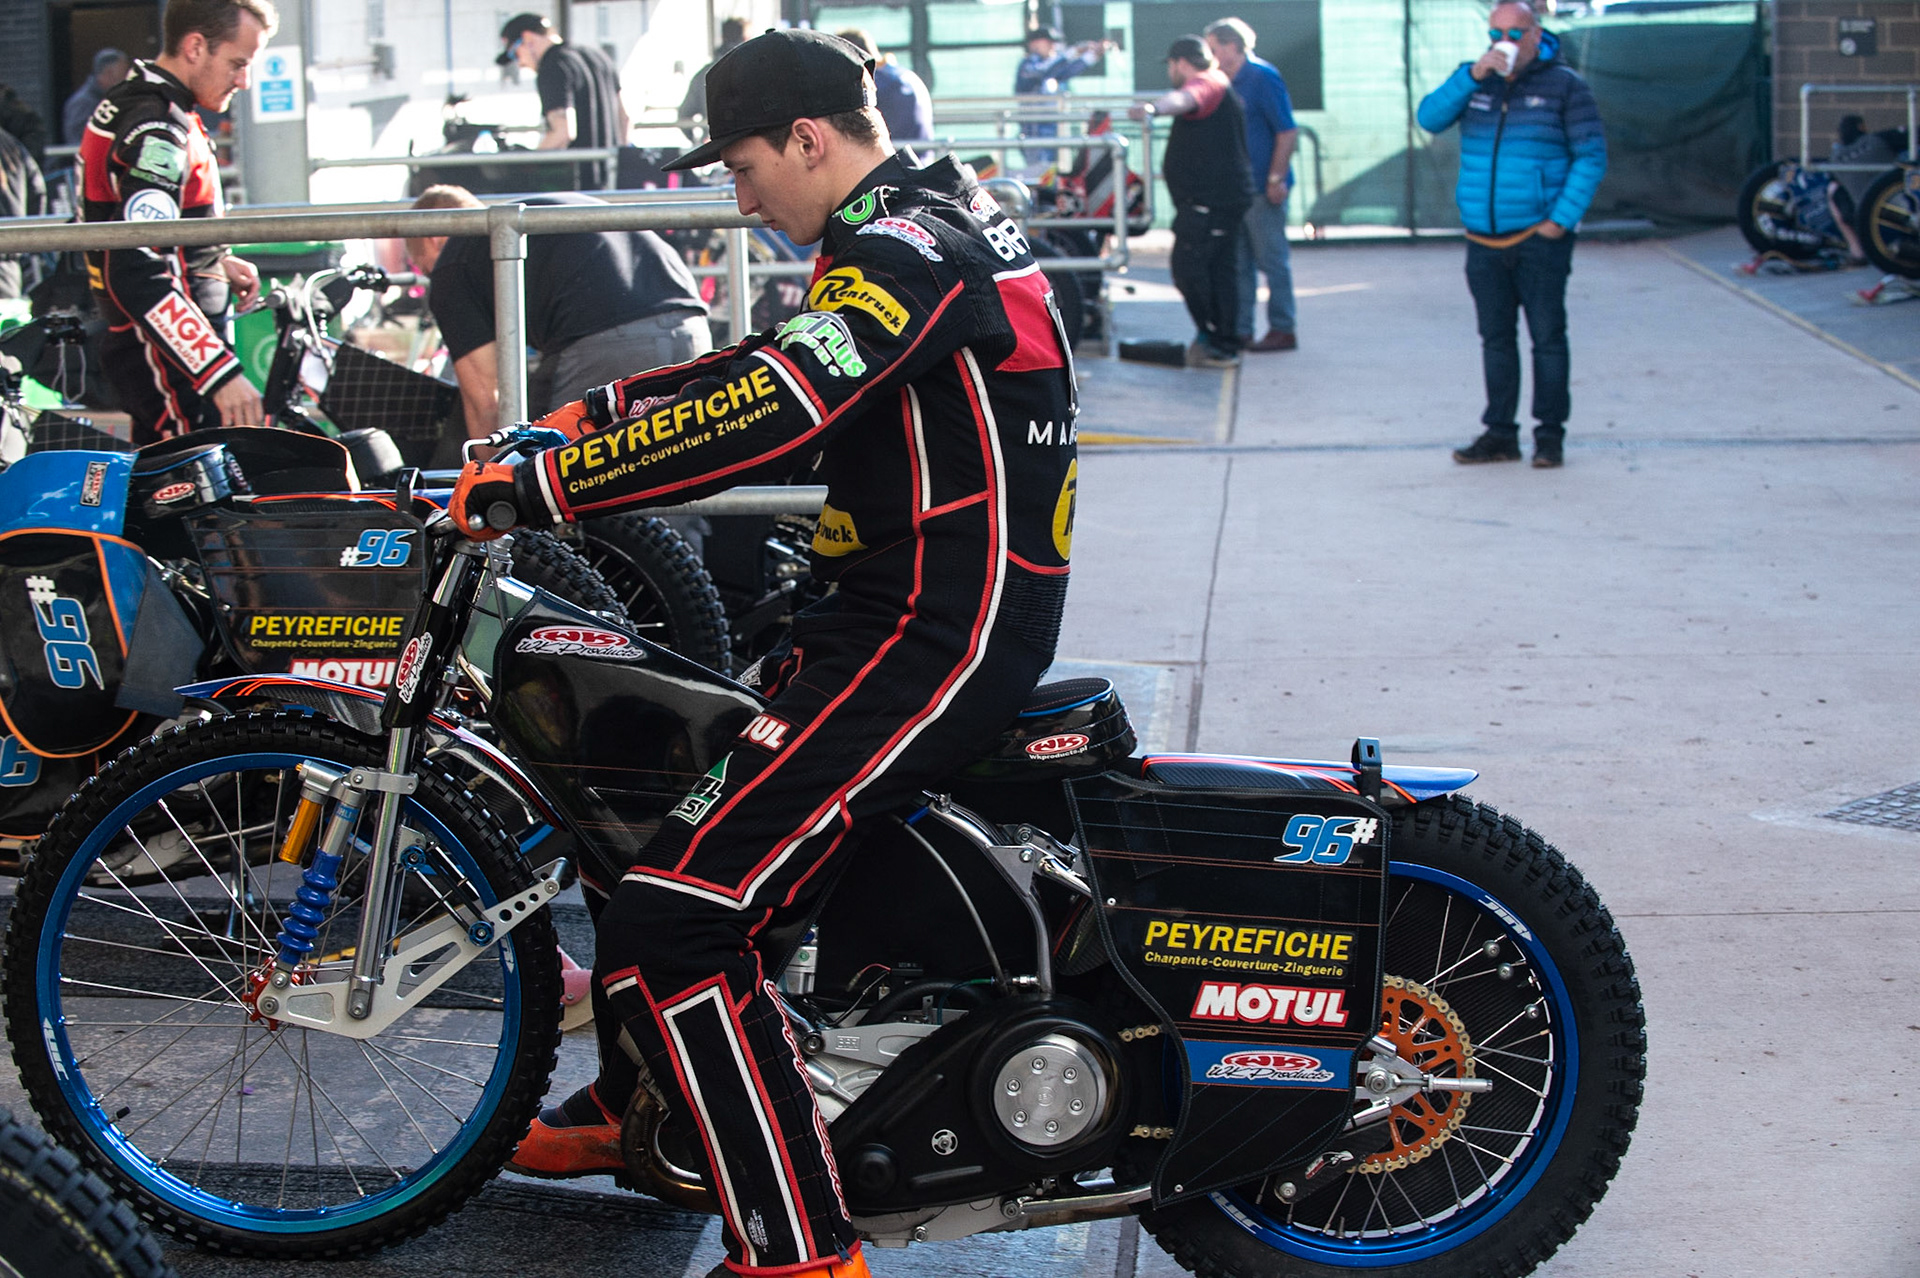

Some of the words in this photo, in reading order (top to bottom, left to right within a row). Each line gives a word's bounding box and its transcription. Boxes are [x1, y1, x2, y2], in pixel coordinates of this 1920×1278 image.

[815, 275, 901, 328] Rentruck
[158, 297, 219, 361] NGK
[558, 365, 777, 479] PEYREFICHE
[569, 430, 712, 493] Charpente-Couverture
[715, 401, 780, 437] Zinguerie
[340, 529, 417, 567] #96
[250, 615, 404, 637] PEYREFICHE
[559, 643, 642, 657] Products
[1144, 920, 1353, 961] PEYREFICHE
[1144, 951, 1344, 977] Charpente-Couverture-Zinguerie
[1194, 983, 1347, 1025] MOTUL
[1248, 1067, 1331, 1080] Products
